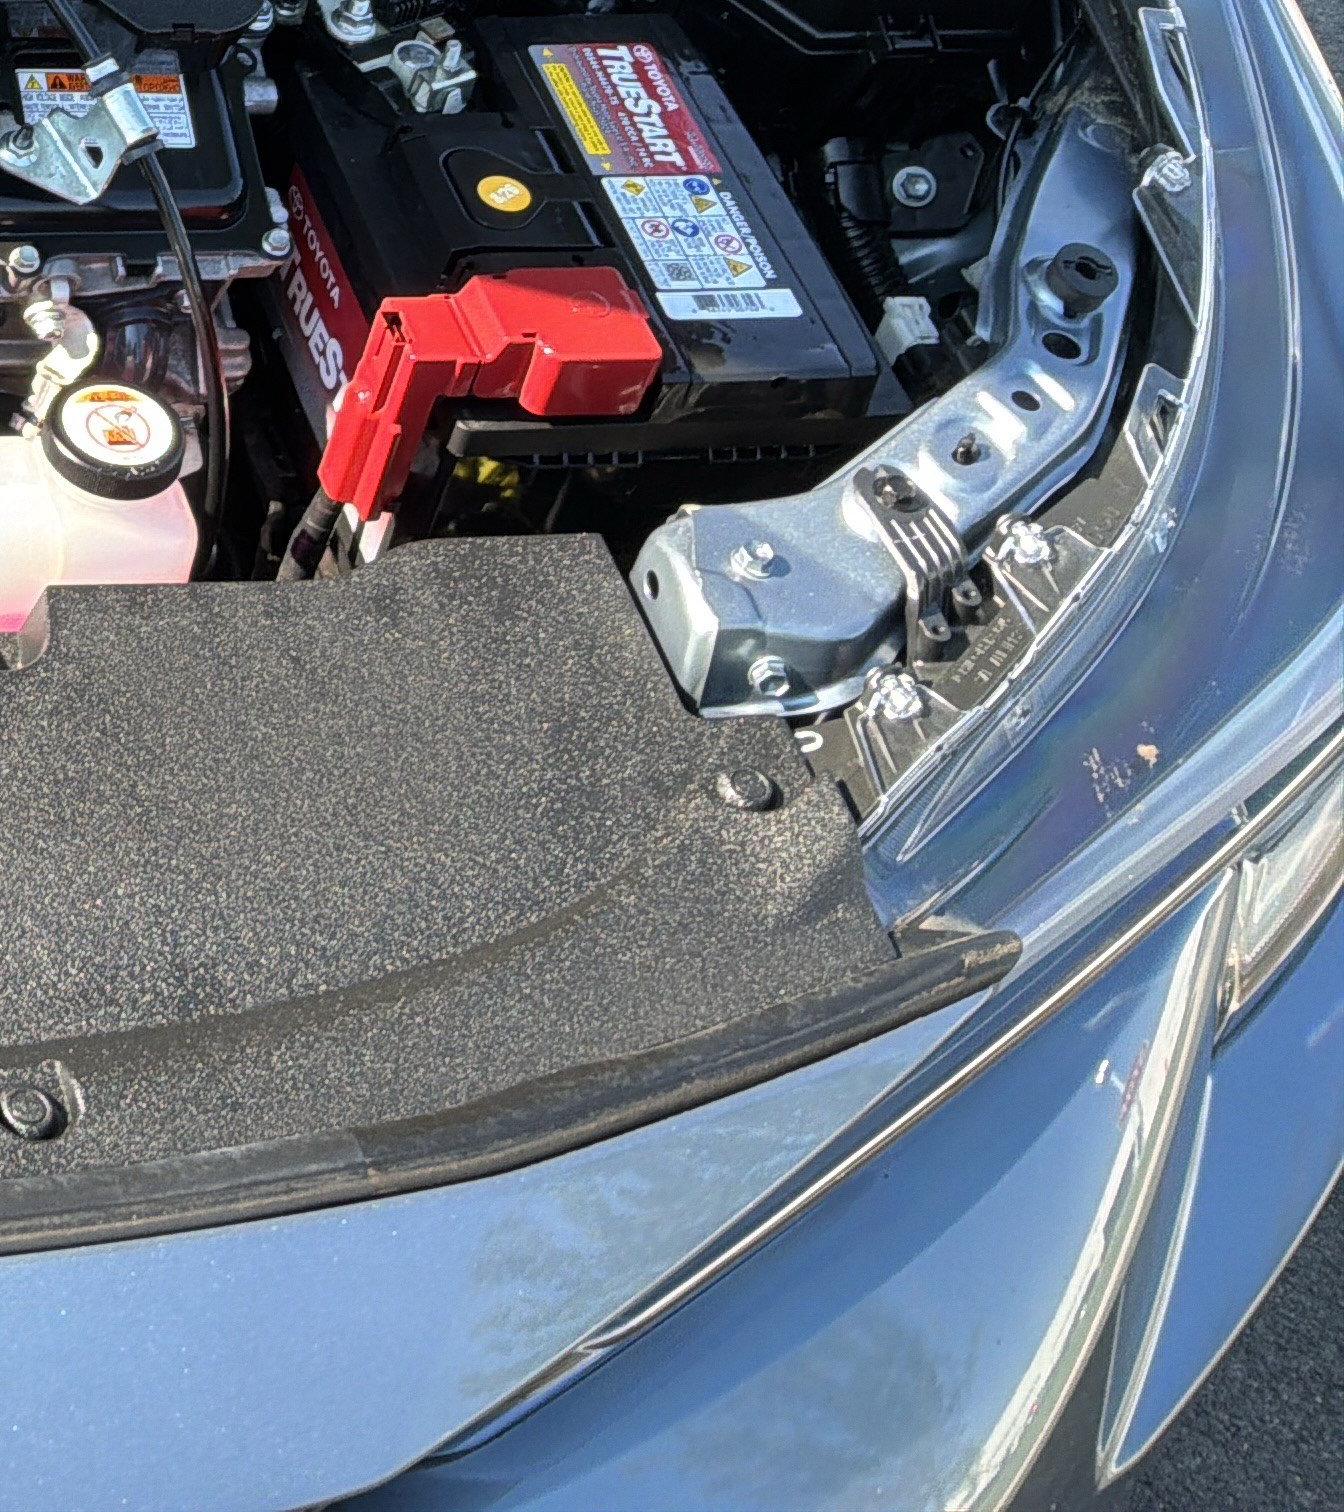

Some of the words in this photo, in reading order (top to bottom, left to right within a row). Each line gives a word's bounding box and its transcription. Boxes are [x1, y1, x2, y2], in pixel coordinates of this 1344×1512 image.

[644, 64, 679, 112] TOYOTA
[303, 214, 340, 310] TOYOTA
[719, 191, 778, 279] DANGER/POISON
